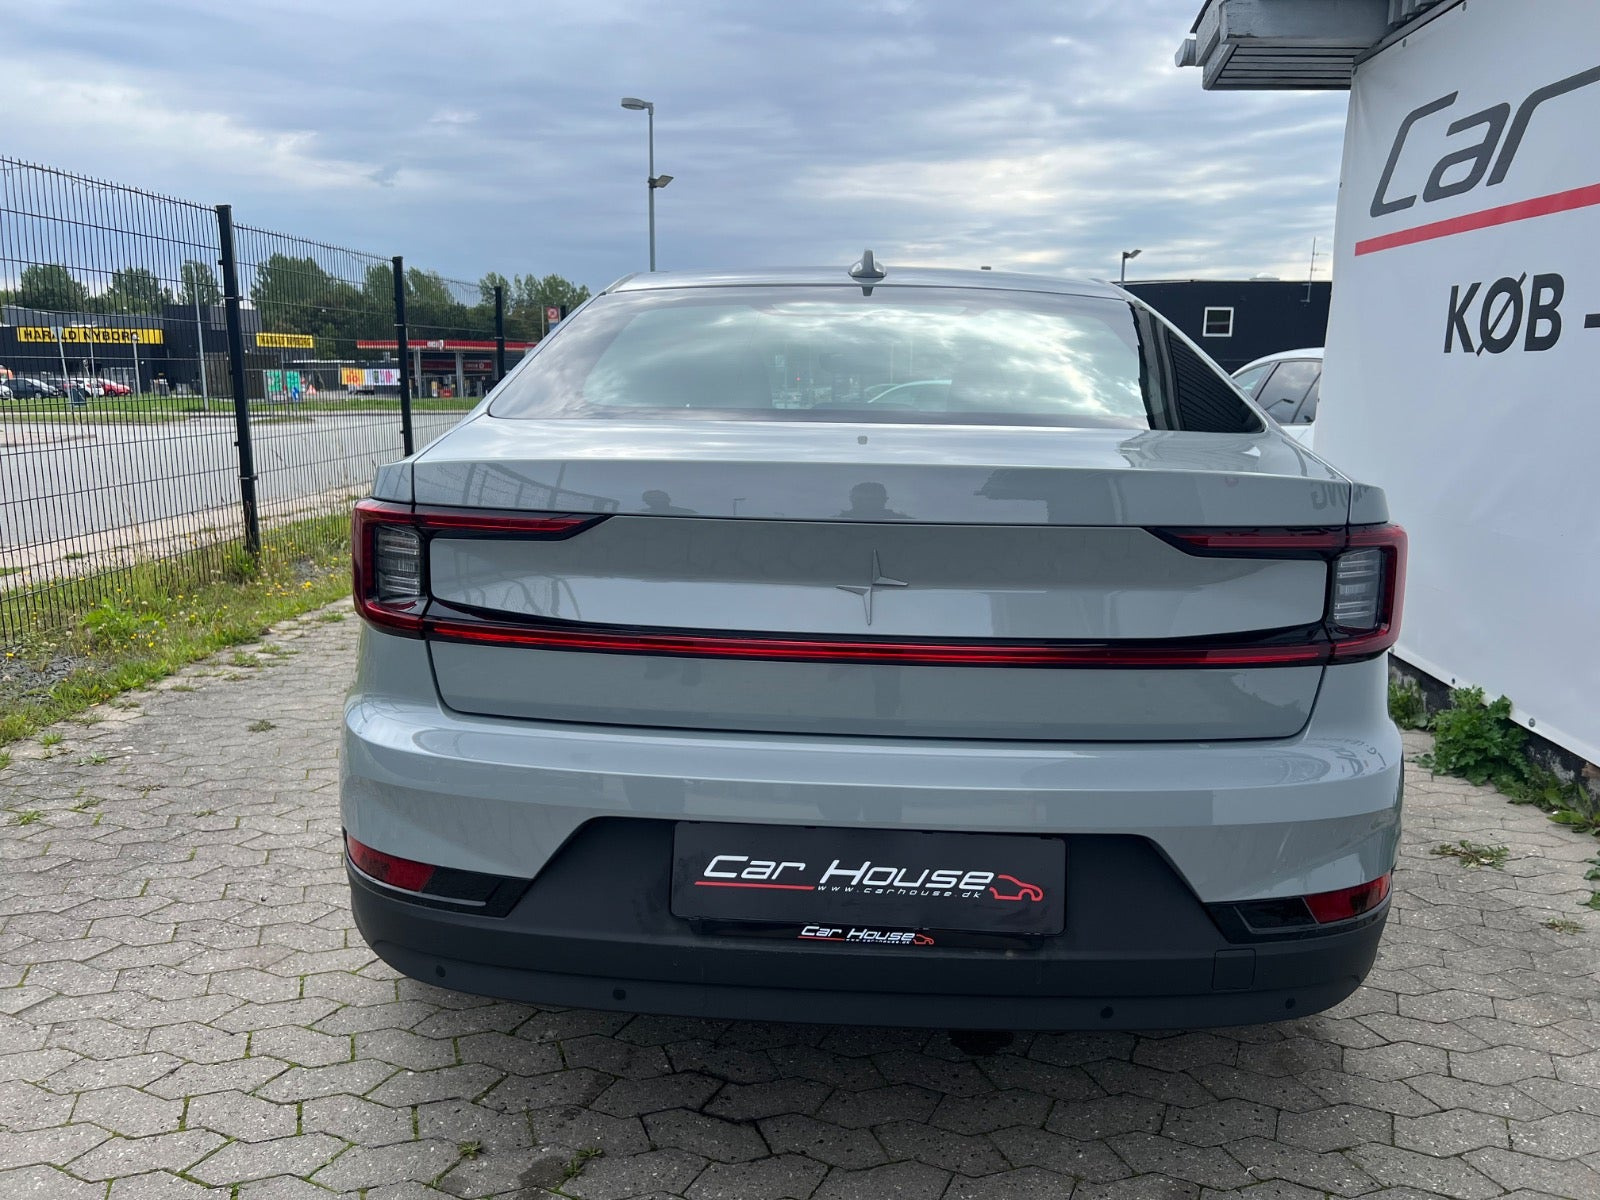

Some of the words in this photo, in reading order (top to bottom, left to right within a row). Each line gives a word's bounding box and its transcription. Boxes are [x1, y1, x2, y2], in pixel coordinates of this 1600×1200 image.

[1369, 65, 1600, 218] Car
[1443, 272, 1565, 357] KØB
[24, 329, 77, 340] HARLD
[703, 855, 806, 880] Car
[819, 859, 995, 891] House
[801, 925, 842, 937] Car
[846, 928, 915, 941] House
